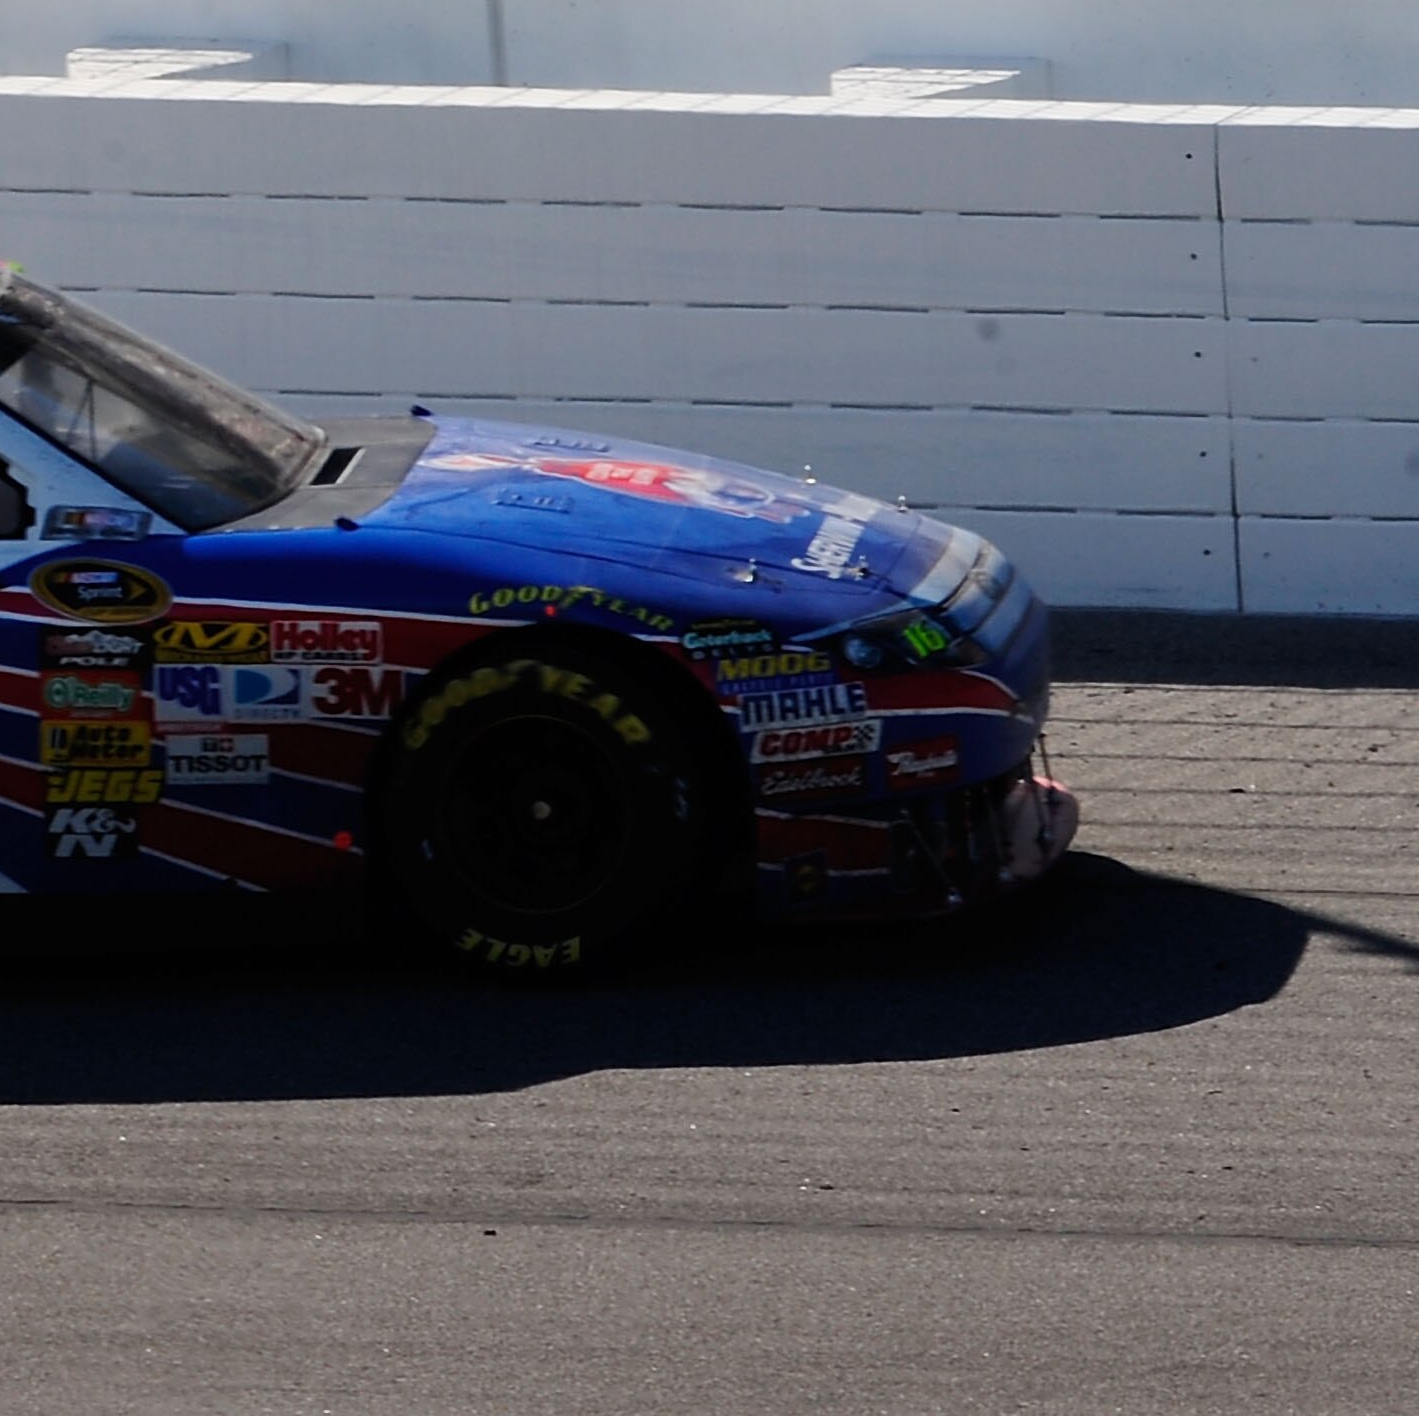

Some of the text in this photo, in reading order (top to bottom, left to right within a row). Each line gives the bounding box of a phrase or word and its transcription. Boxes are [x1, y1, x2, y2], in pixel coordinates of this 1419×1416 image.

[77, 585, 124, 601] Sprint
[275, 622, 377, 660] Holley
[716, 651, 832, 683] MOOG
[159, 666, 221, 715] USG
[314, 668, 403, 716] 3M
[742, 683, 866, 725] MAHLE
[74, 725, 131, 742] Auto
[759, 725, 854, 757] COMP
[169, 755, 267, 773] TISSOT
[45, 769, 164, 803] JEGS
[457, 925, 583, 969] EAGLE
